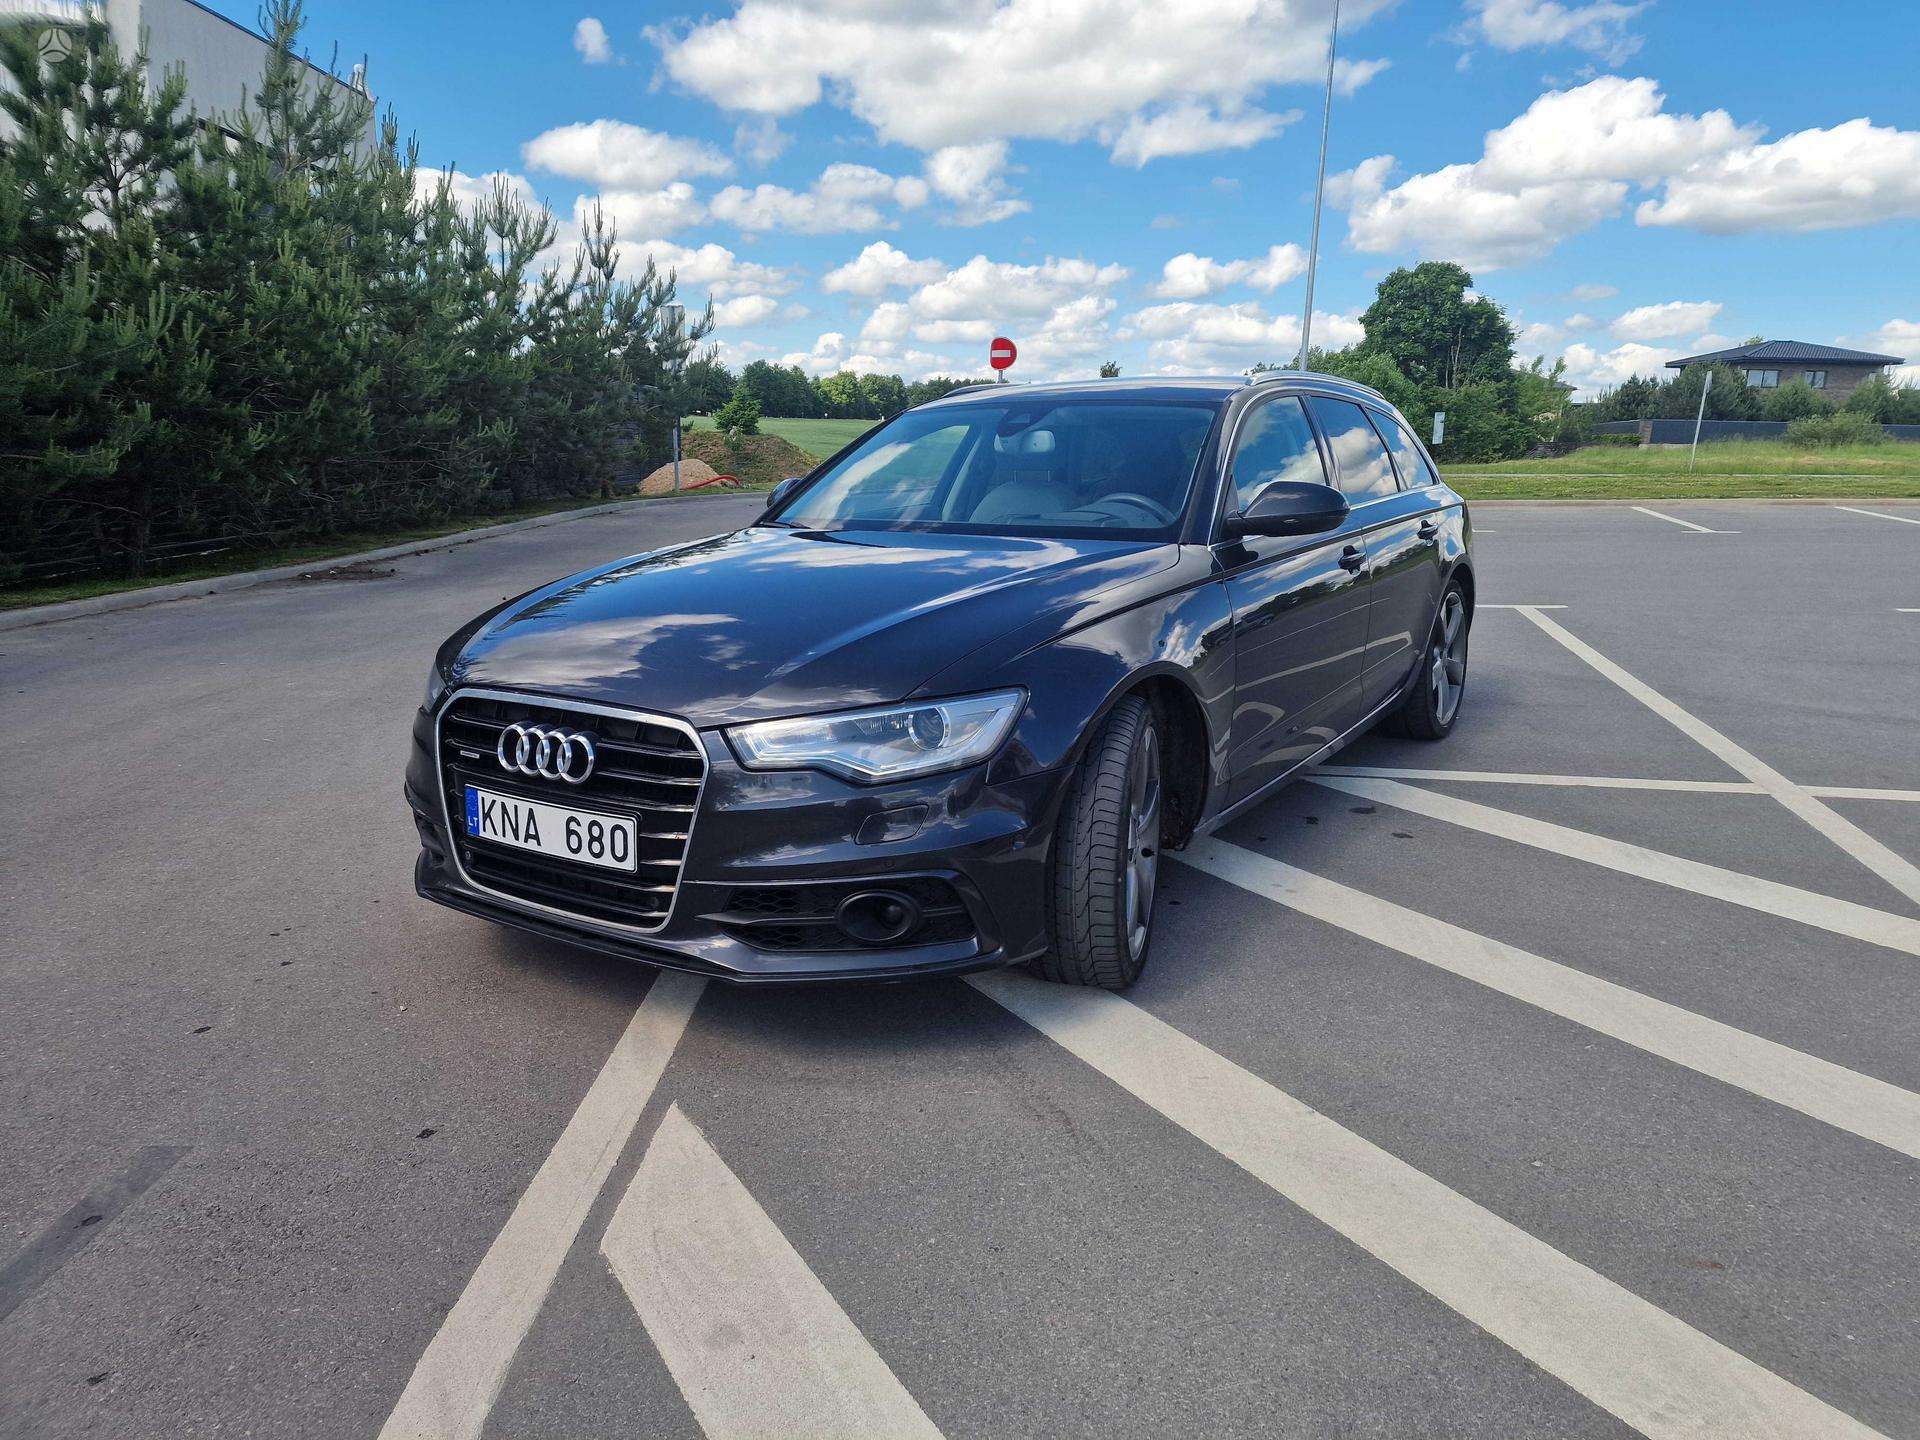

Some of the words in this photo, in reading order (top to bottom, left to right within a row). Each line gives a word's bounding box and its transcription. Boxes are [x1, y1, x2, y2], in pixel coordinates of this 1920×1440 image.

[467, 815, 478, 828] LT
[481, 796, 542, 847] KNA
[565, 815, 629, 863] 680
